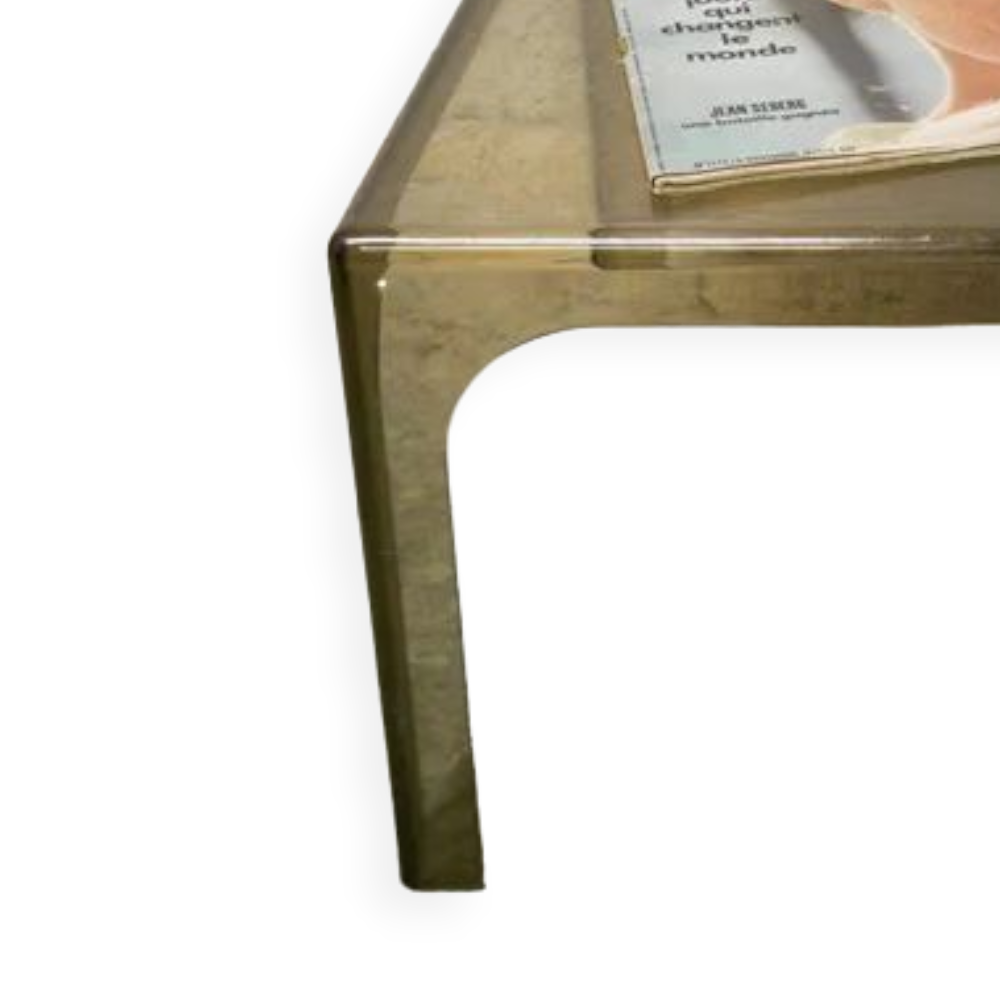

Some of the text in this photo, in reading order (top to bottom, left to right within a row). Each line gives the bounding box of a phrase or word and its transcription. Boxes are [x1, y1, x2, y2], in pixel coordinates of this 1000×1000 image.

[703, 3, 751, 19] qui
[660, 12, 802, 36] changent
[720, 32, 750, 45] le
[686, 43, 798, 62] monde
